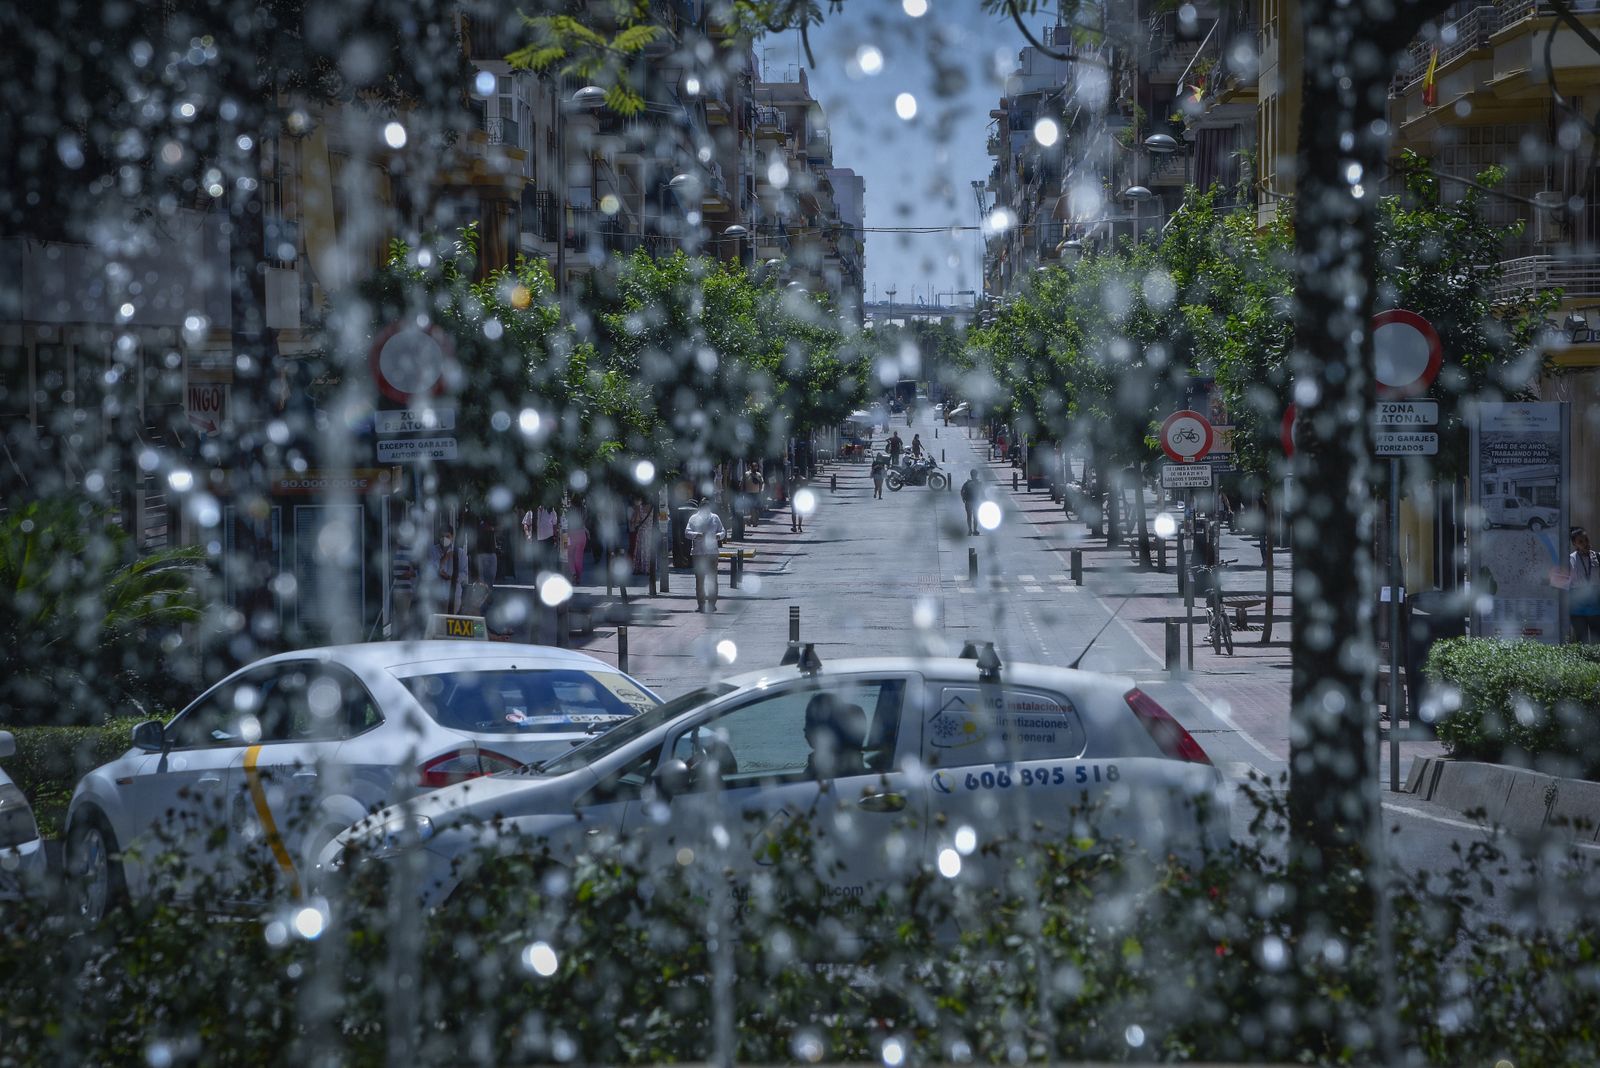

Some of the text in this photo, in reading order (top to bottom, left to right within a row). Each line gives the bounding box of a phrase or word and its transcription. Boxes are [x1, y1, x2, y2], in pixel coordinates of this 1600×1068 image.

[188, 387, 219, 412] INGO
[1382, 404, 1414, 413] ZONA
[1378, 414, 1429, 423] ATONAL
[384, 420, 447, 431] PEATOL
[379, 442, 415, 450] EXCEPTO
[1375, 444, 1424, 452] UTORIZADOS
[391, 450, 444, 458] AUTORIDOS
[447, 619, 473, 636] TAXI
[1007, 701, 1073, 712] instalaciones
[992, 716, 1069, 729] limtizaciones
[964, 764, 1120, 791] 606 895 518
